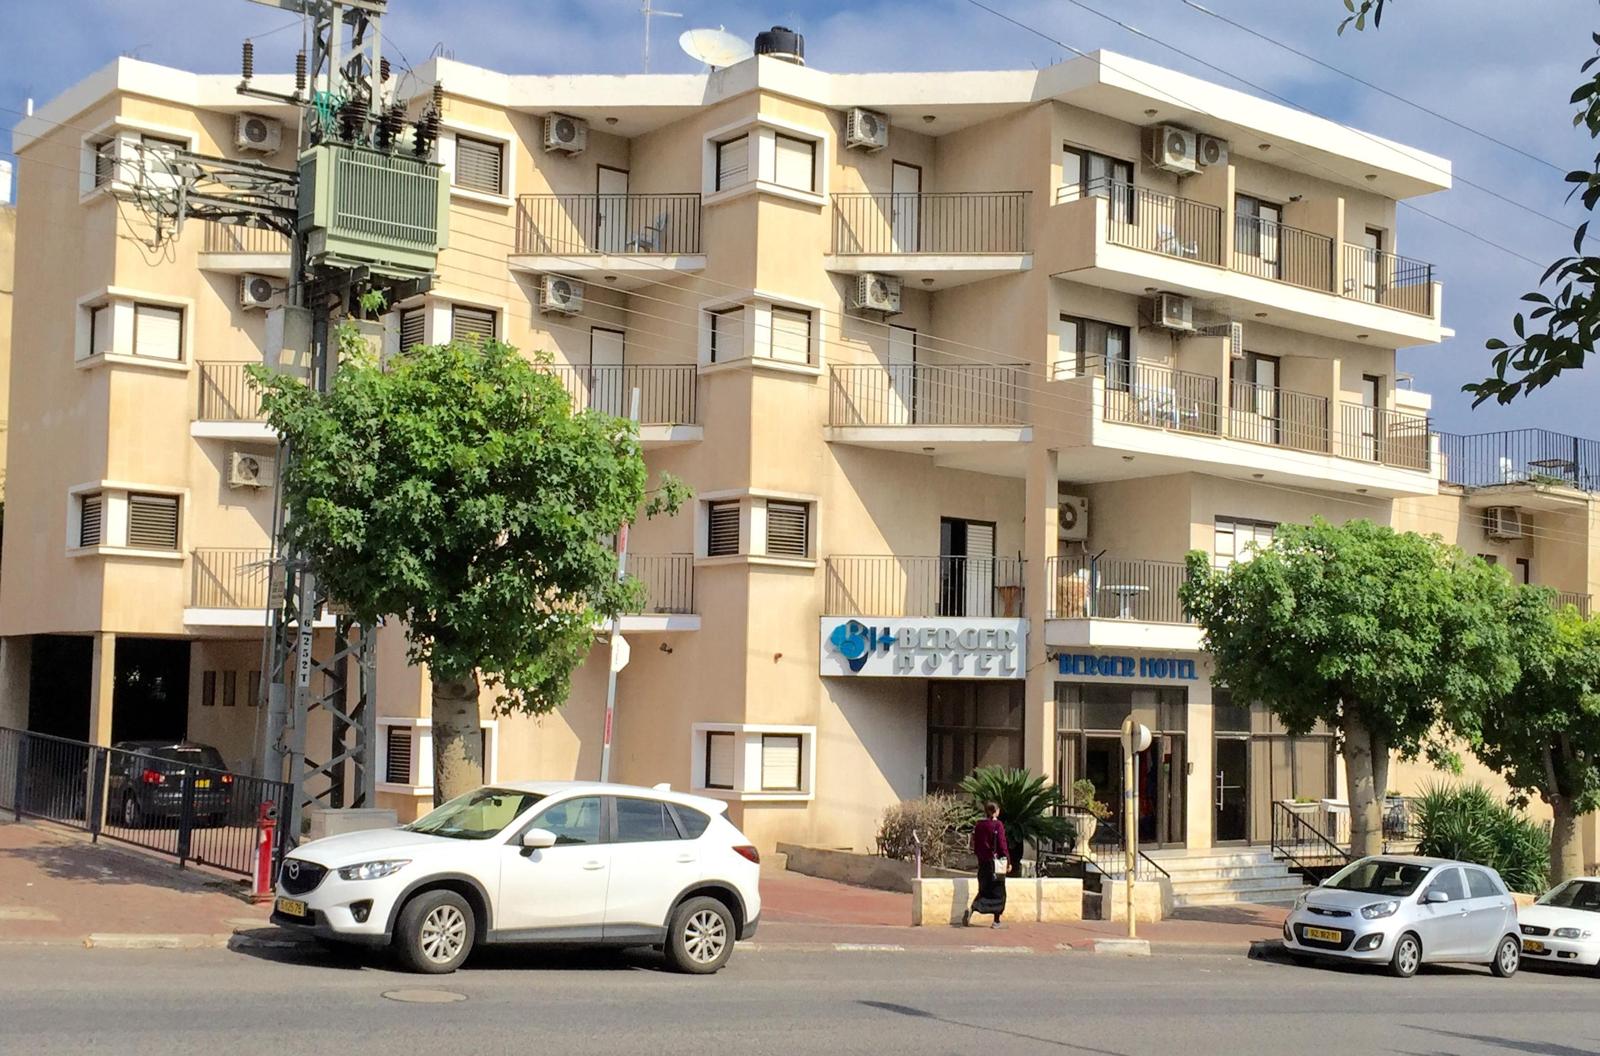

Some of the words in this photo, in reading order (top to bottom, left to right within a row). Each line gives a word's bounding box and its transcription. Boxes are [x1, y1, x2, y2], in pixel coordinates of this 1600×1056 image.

[898, 627, 1017, 650] BERGER
[899, 652, 1017, 671] HOTEL
[1058, 653, 1136, 677] BERGER
[1139, 656, 1199, 680] HOTEL
